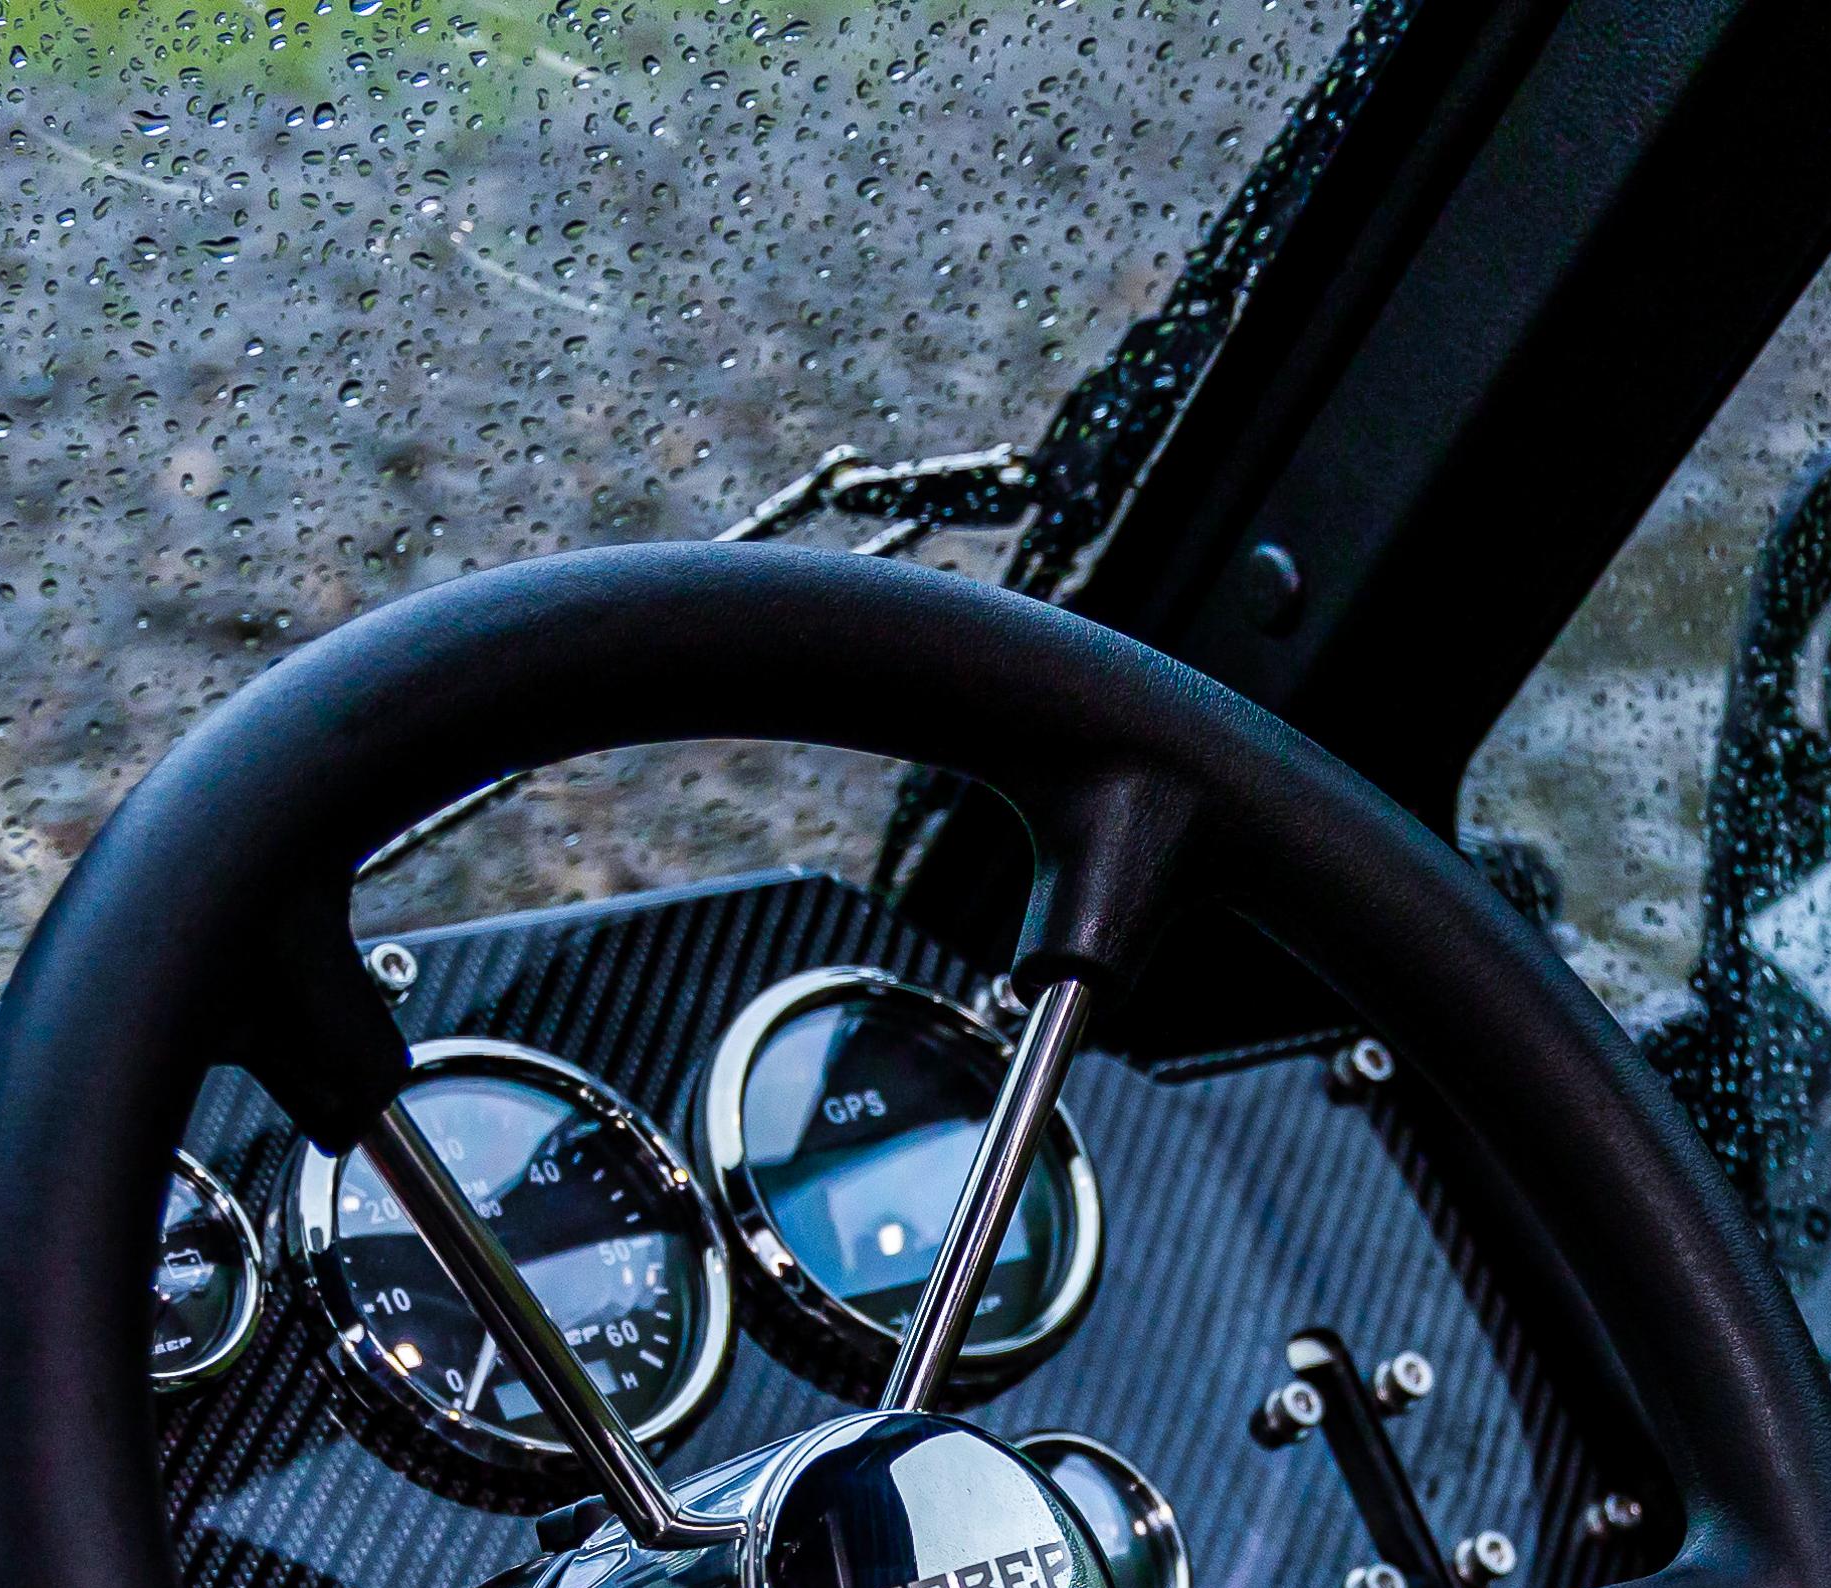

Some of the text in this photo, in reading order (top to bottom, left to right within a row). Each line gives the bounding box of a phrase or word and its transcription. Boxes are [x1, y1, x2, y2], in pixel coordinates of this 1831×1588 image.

[823, 1089, 887, 1125] GPS
[530, 1159, 561, 1185] 40
[365, 1198, 401, 1225] 20
[599, 1239, 631, 1266] 50
[376, 1288, 411, 1315] 10
[605, 1319, 640, 1347] 60
[445, 1368, 464, 1393] 0
